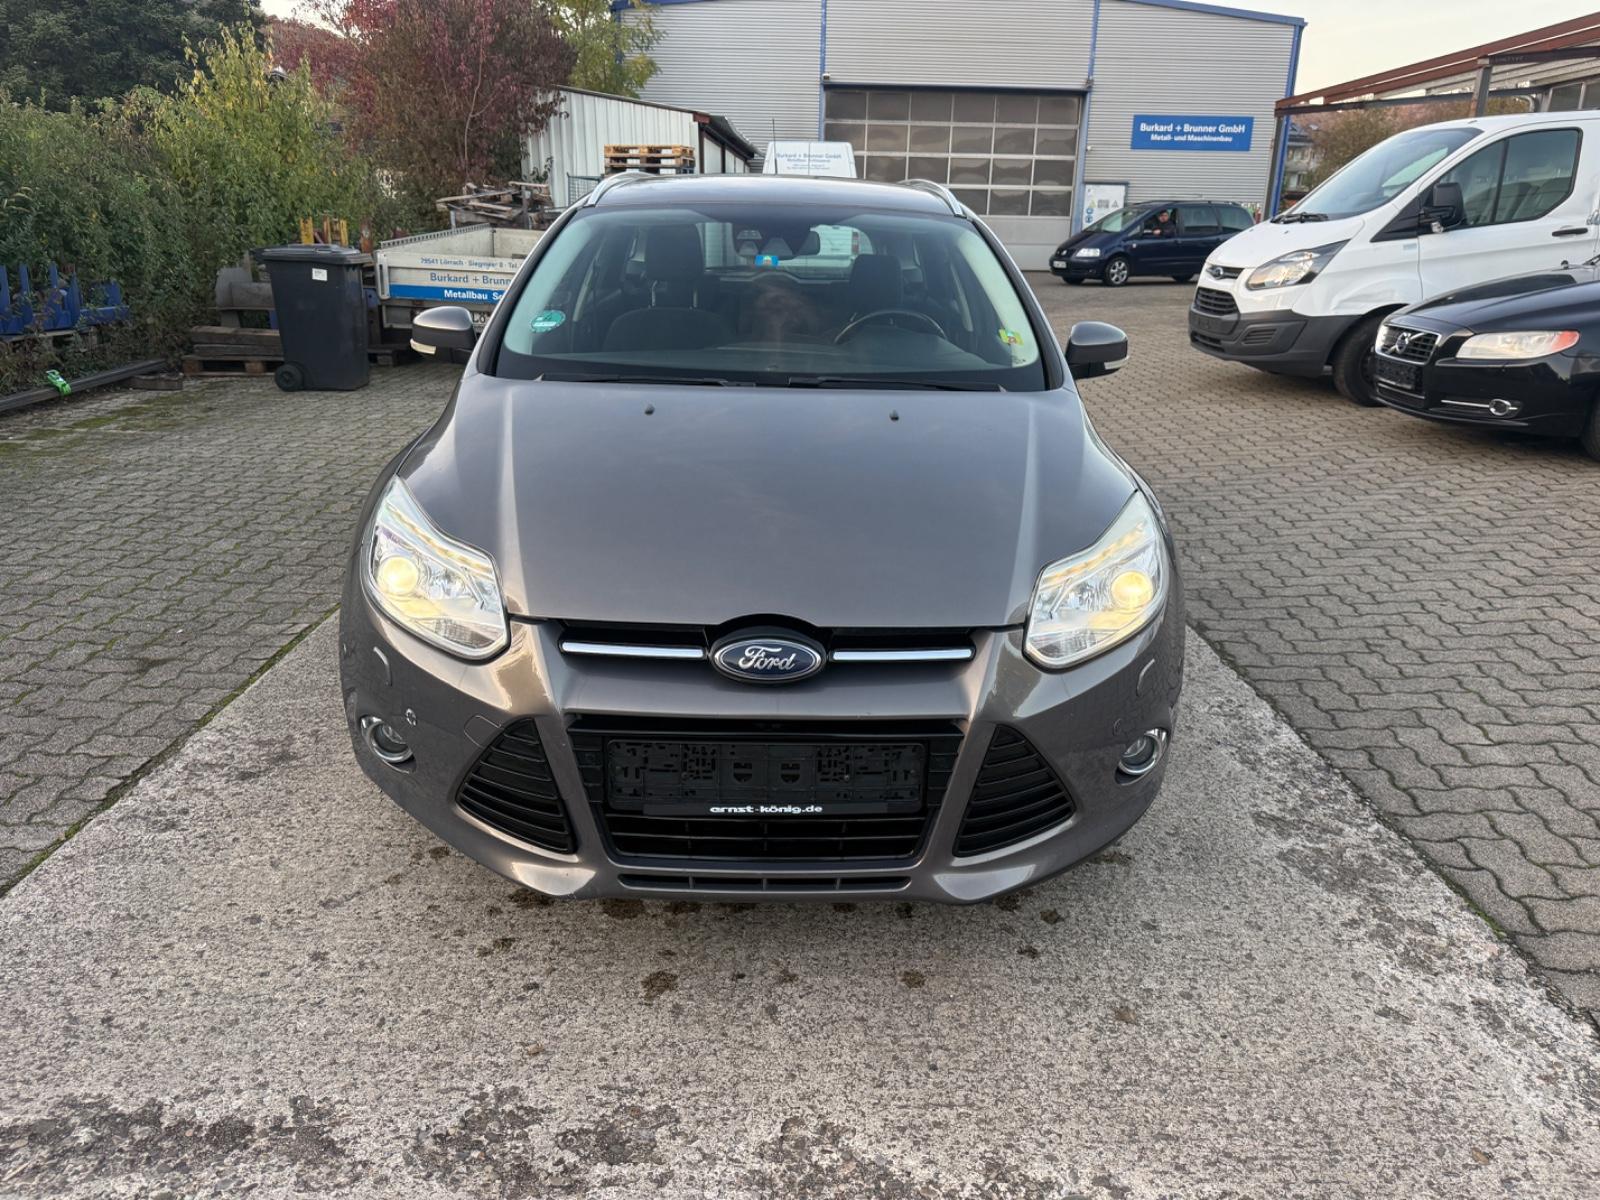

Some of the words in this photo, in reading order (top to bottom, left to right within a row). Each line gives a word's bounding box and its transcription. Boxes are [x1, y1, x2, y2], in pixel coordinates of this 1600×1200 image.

[1140, 122, 1173, 132] Burkard
[1183, 123, 1217, 132] Brunner
[1218, 123, 1246, 133] GmbH
[1187, 134, 1233, 142] Maschinenbau
[430, 272, 469, 284] Burkard
[472, 276, 480, 284] +
[444, 289, 488, 300] Metallbau
[738, 645, 797, 670] Ford
